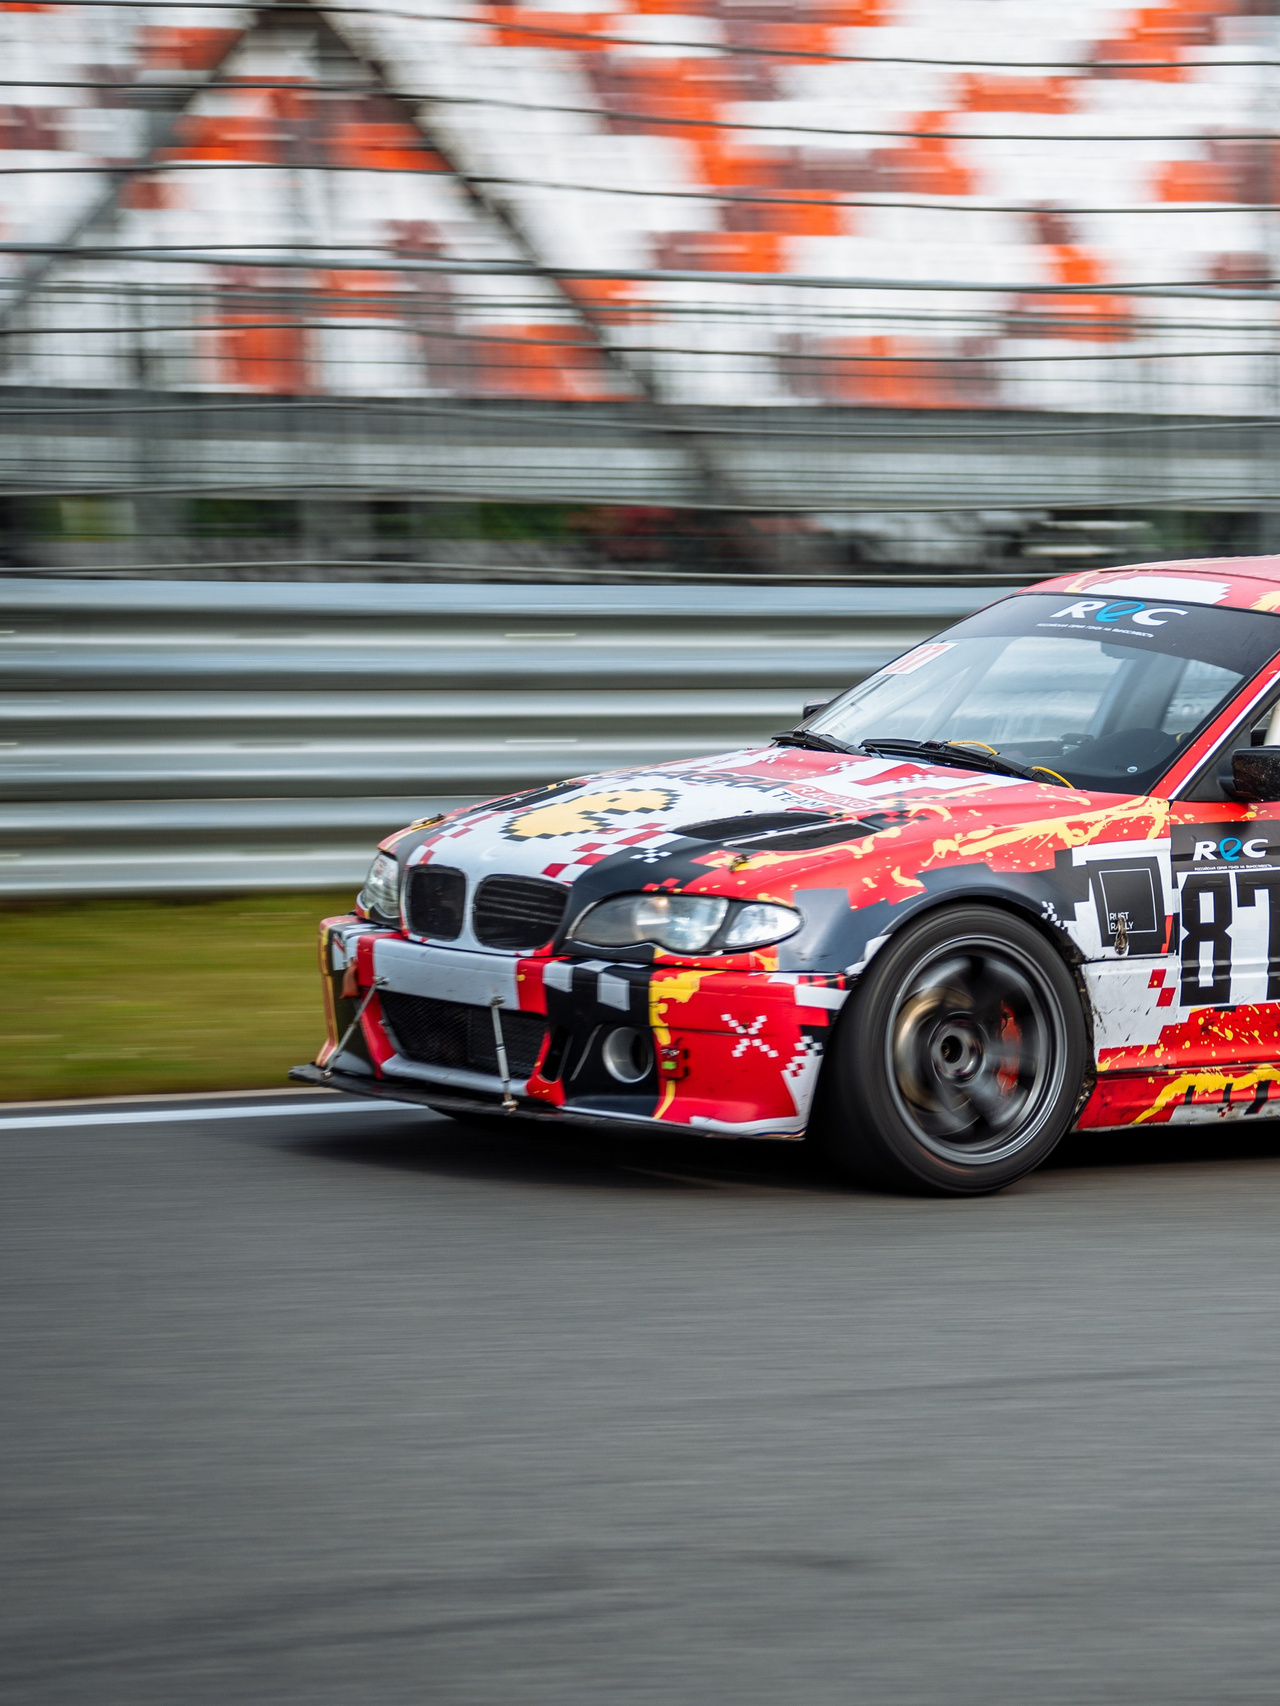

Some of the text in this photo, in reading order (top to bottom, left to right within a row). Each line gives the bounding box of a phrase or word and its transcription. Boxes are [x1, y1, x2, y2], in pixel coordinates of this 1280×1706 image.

[772, 790, 826, 808] TEAM
[795, 786, 872, 809] RACING
[1110, 921, 1134, 931] RLY
